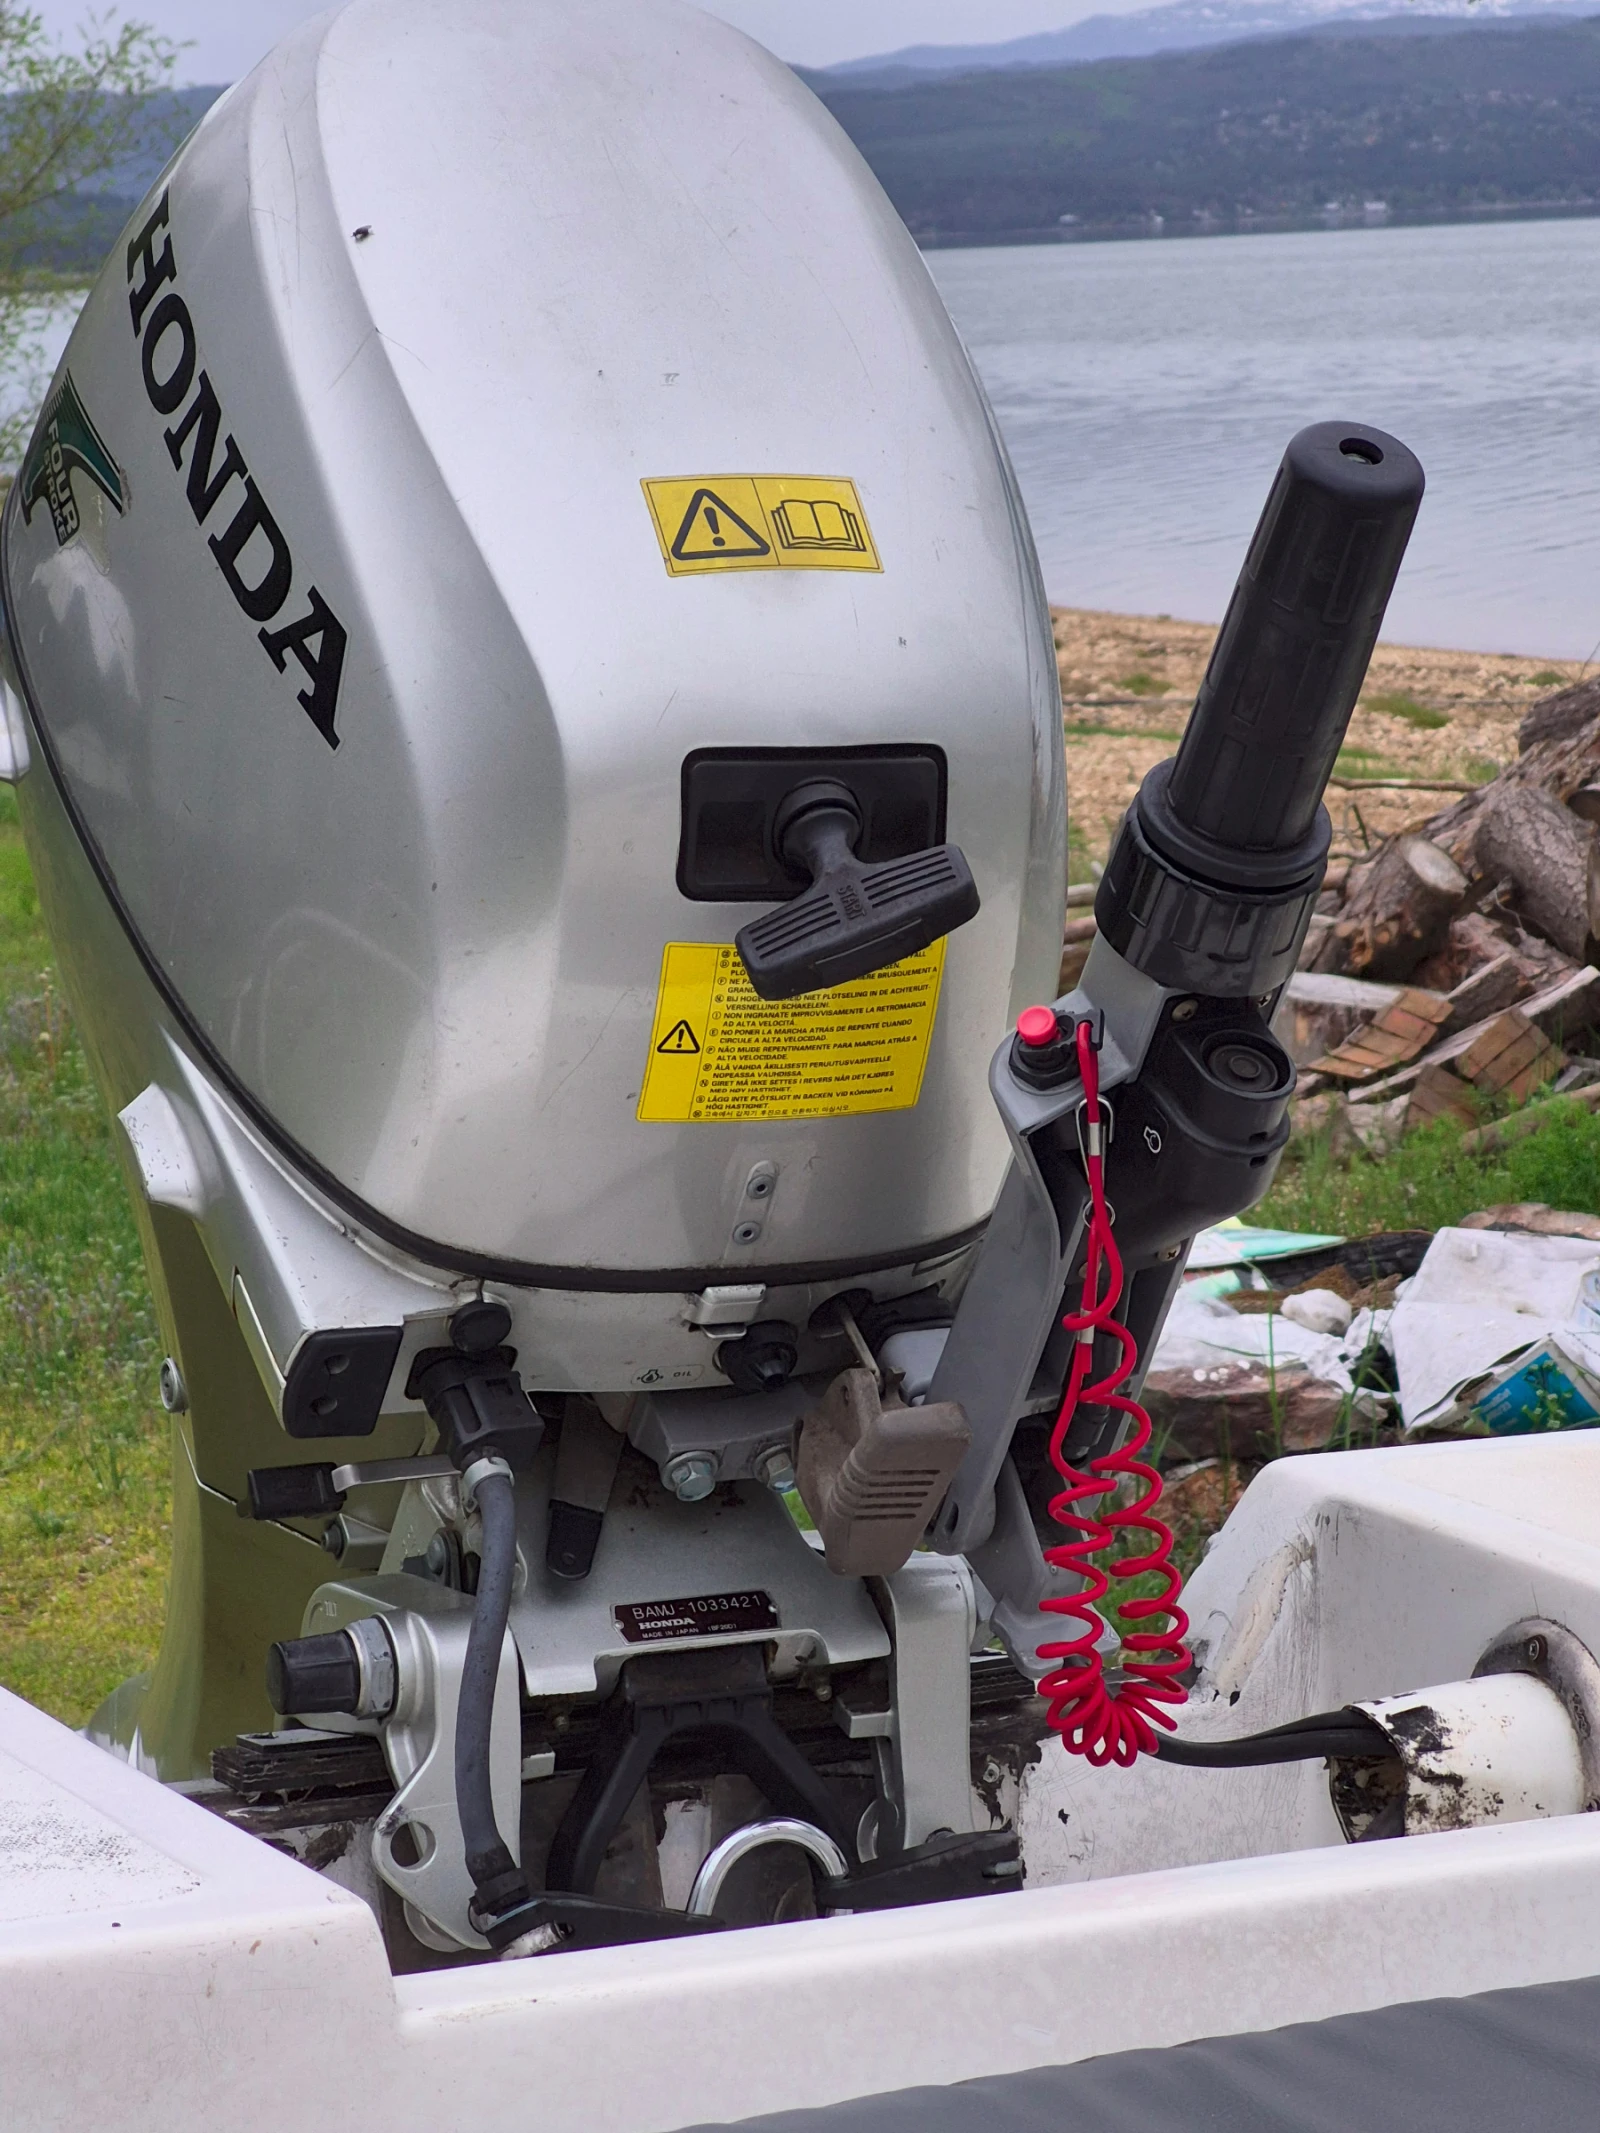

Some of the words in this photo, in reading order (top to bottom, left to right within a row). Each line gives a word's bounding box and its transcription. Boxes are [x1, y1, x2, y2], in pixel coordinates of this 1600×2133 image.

[127, 184, 348, 751] HONDA
[48, 417, 79, 535] FOUR
[43, 449, 67, 542] STROKE
[878, 968, 931, 978] BRUSQUEMENT
[823, 990, 868, 1000] PLOTSELING
[726, 1003, 779, 1011] VERSNELLING
[744, 1011, 788, 1019] INGRANATE
[791, 1007, 864, 1017] IMPROVVISAMENTE
[876, 1001, 927, 1012] RETROMARCIA
[774, 1027, 807, 1035] MARCHA
[847, 1022, 880, 1031] REPENTE
[881, 1019, 913, 1028] CUANDO
[762, 1044, 831, 1052] REPENTINAMENTE
[854, 1039, 886, 1048] MARCHA
[803, 1076, 832, 1084] REVERS
[803, 1091, 833, 1100] BACKEN
[638, 1617, 696, 1630] HONDA
